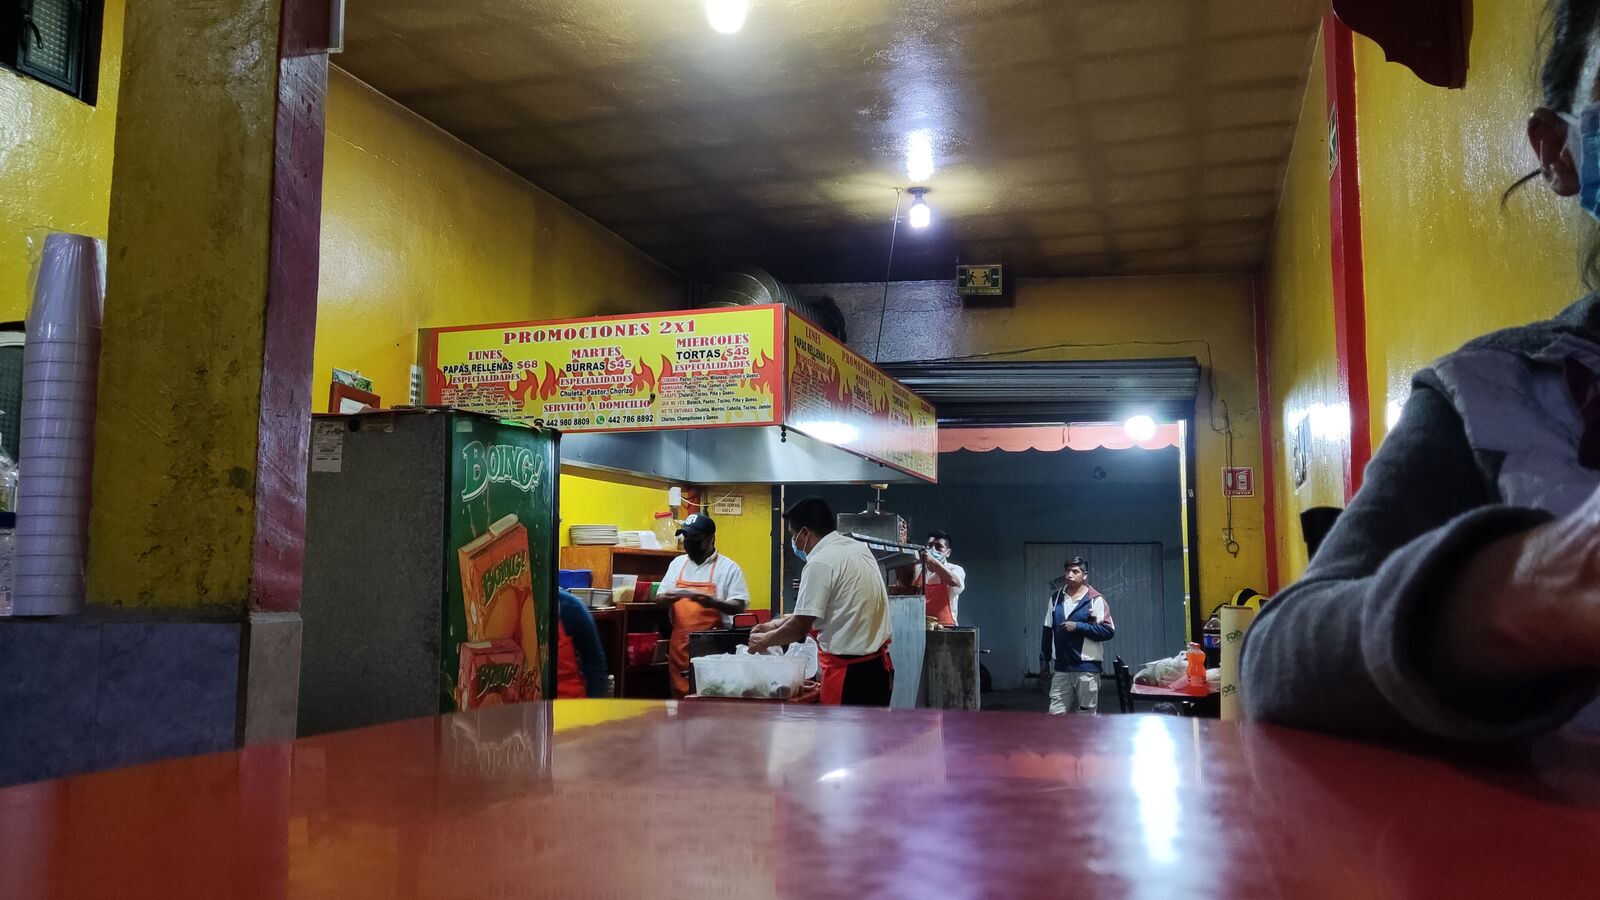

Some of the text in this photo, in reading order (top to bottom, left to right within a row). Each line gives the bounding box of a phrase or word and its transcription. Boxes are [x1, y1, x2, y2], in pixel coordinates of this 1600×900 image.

[503, 322, 650, 345] PROMOCIONES
[676, 333, 750, 348] MIERCOLES
[467, 349, 503, 361] LUNES
[571, 346, 621, 359] MARTES
[676, 347, 750, 360] TORTAS $48
[443, 360, 538, 374] PAPAS RELLENAS $68
[565, 359, 632, 373] BURRAS $45
[675, 360, 751, 372] ESPECIALIDADES
[452, 373, 520, 384] ESPECIALIDADES
[560, 374, 633, 386] ESPECIALIDADES
[560, 386, 633, 398] Chuleta, Pastor, Chorizo
[544, 400, 651, 413] SERVICIO A DOMICILIO
[546, 417, 590, 427] 442 980 8809
[608, 414, 654, 425] 442 786 8892
[461, 440, 544, 502] BOING!
